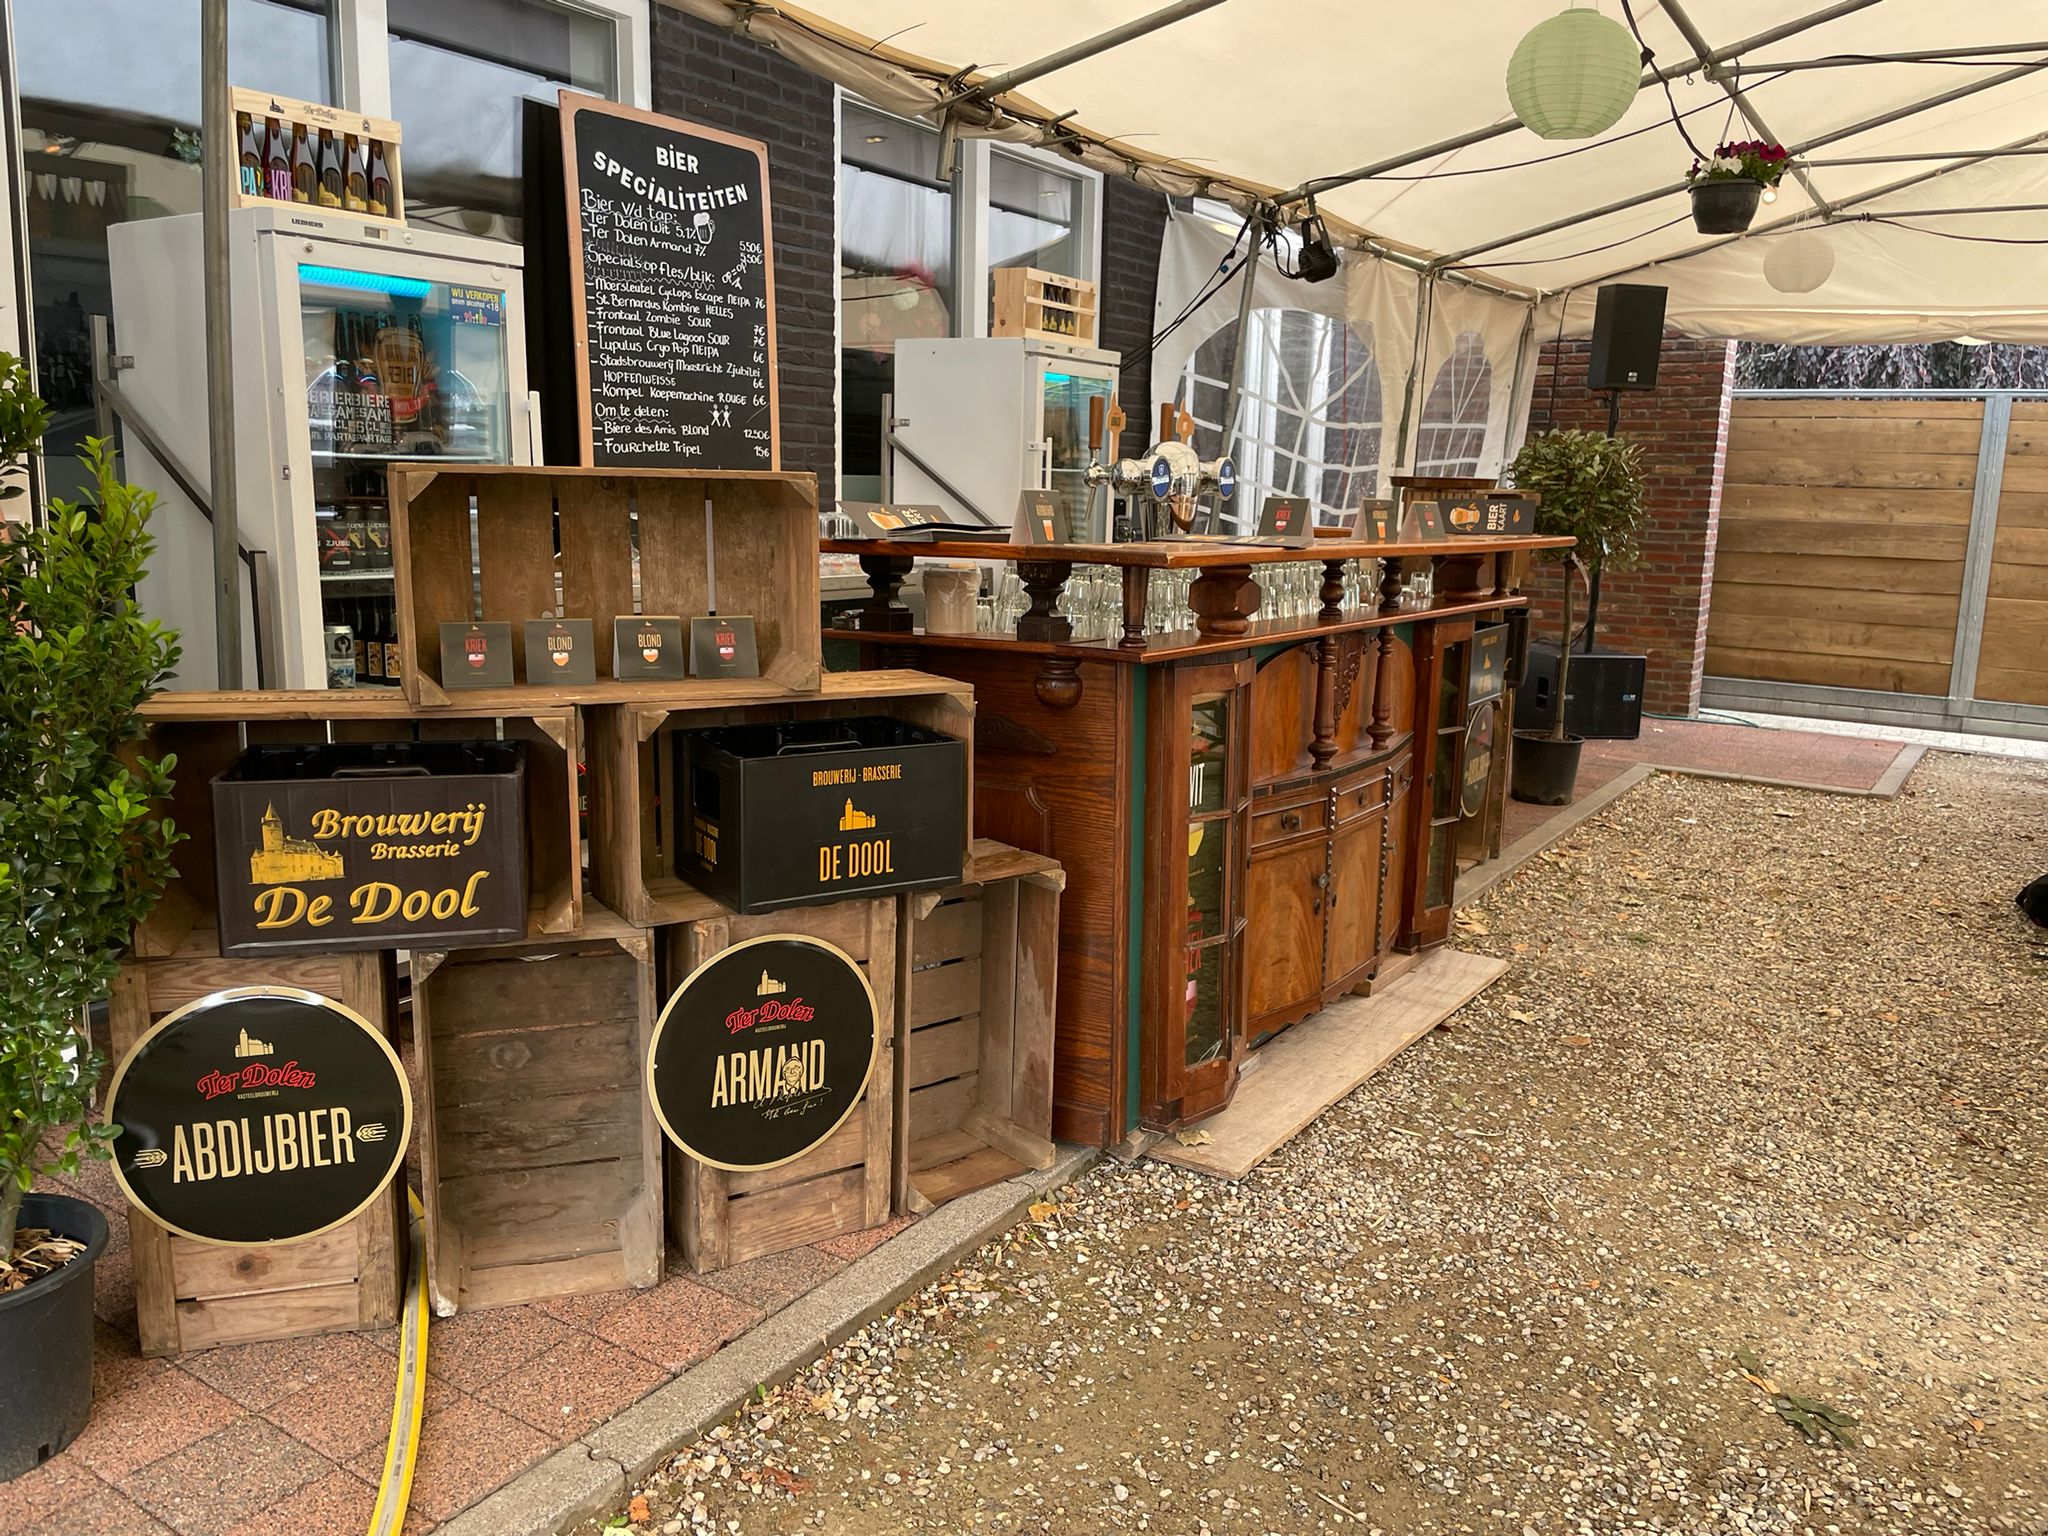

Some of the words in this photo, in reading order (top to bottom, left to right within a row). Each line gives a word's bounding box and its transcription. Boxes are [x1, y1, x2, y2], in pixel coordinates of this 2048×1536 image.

[656, 144, 699, 174] BIER
[593, 151, 748, 211] SPECIALITEITEN
[581, 188, 614, 210] Bier
[647, 204, 677, 224] tap:
[589, 209, 609, 225] Ter
[614, 212, 648, 232] Dolen
[650, 220, 671, 235] Wit
[675, 224, 697, 240] 5.1%
[589, 223, 610, 239] Ter
[614, 228, 648, 246] Dolen
[650, 237, 692, 255] Armand
[695, 243, 707, 257] 7%
[588, 243, 643, 269] Specials
[643, 260, 658, 275] op
[595, 277, 656, 296] Moersleutel
[658, 285, 693, 301] Cyclops
[694, 289, 724, 306] Escape
[727, 293, 751, 308] NEIPA
[754, 296, 766, 309] 7€
[596, 307, 642, 321] Frontaal
[646, 311, 682, 326] Zombie
[687, 315, 712, 328] SOUR
[610, 293, 661, 311] Bernardus
[662, 300, 701, 314] Kombine
[705, 304, 734, 319] HELLES
[596, 321, 645, 337] Frontaal
[648, 326, 672, 339] Blue
[673, 328, 706, 346] Lagoon
[707, 332, 731, 346] SOUR
[753, 324, 766, 337] 7€
[753, 336, 766, 348] 7€
[600, 334, 642, 354] Lupulus
[646, 339, 670, 359] Cryo
[671, 341, 690, 357] Pop
[691, 344, 720, 359] NEIPA
[753, 350, 766, 364] 6€
[600, 353, 675, 376] Stadsbrouwerij
[676, 359, 723, 374] Maastricht
[726, 362, 761, 378] Zjubilei
[603, 369, 677, 387] HOPFENWEISSE
[602, 381, 645, 401] Kompel
[649, 386, 715, 402] Koepemachine
[717, 392, 748, 406] ROUGE
[752, 394, 767, 407] 6€
[752, 377, 766, 390] 6€
[595, 402, 617, 417] Om
[619, 403, 632, 417] te
[633, 404, 669, 418] delen:
[604, 420, 632, 435] Biere
[633, 422, 652, 435] des
[653, 424, 677, 435] Amis
[681, 424, 710, 436] Blond
[604, 437, 671, 454] Fourchette
[672, 440, 703, 458] Tripel
[753, 445, 770, 458] 15€
[1486, 504, 1498, 531] BIER
[1497, 503, 1507, 531] KAART
[464, 637, 488, 653] KRIEK
[547, 636, 573, 651] BLOND
[637, 633, 662, 648] BLOND
[714, 631, 737, 647] KRIEK
[812, 767, 857, 787] BROUWERIJ
[862, 763, 902, 782] BRASSERIE
[311, 802, 488, 847] Brouwerij
[371, 839, 461, 861] Brasserie
[819, 845, 842, 882] DE
[848, 839, 894, 878] DOOL
[254, 886, 334, 930] De
[349, 870, 490, 924] Dool
[725, 1006, 759, 1035] Ter
[759, 997, 815, 1024] Dolen
[197, 1069, 239, 1100] Ter
[241, 1060, 316, 1090] Dolen
[711, 1039, 826, 1109] ARMAND
[173, 1106, 355, 1183] ABDIJBIER
